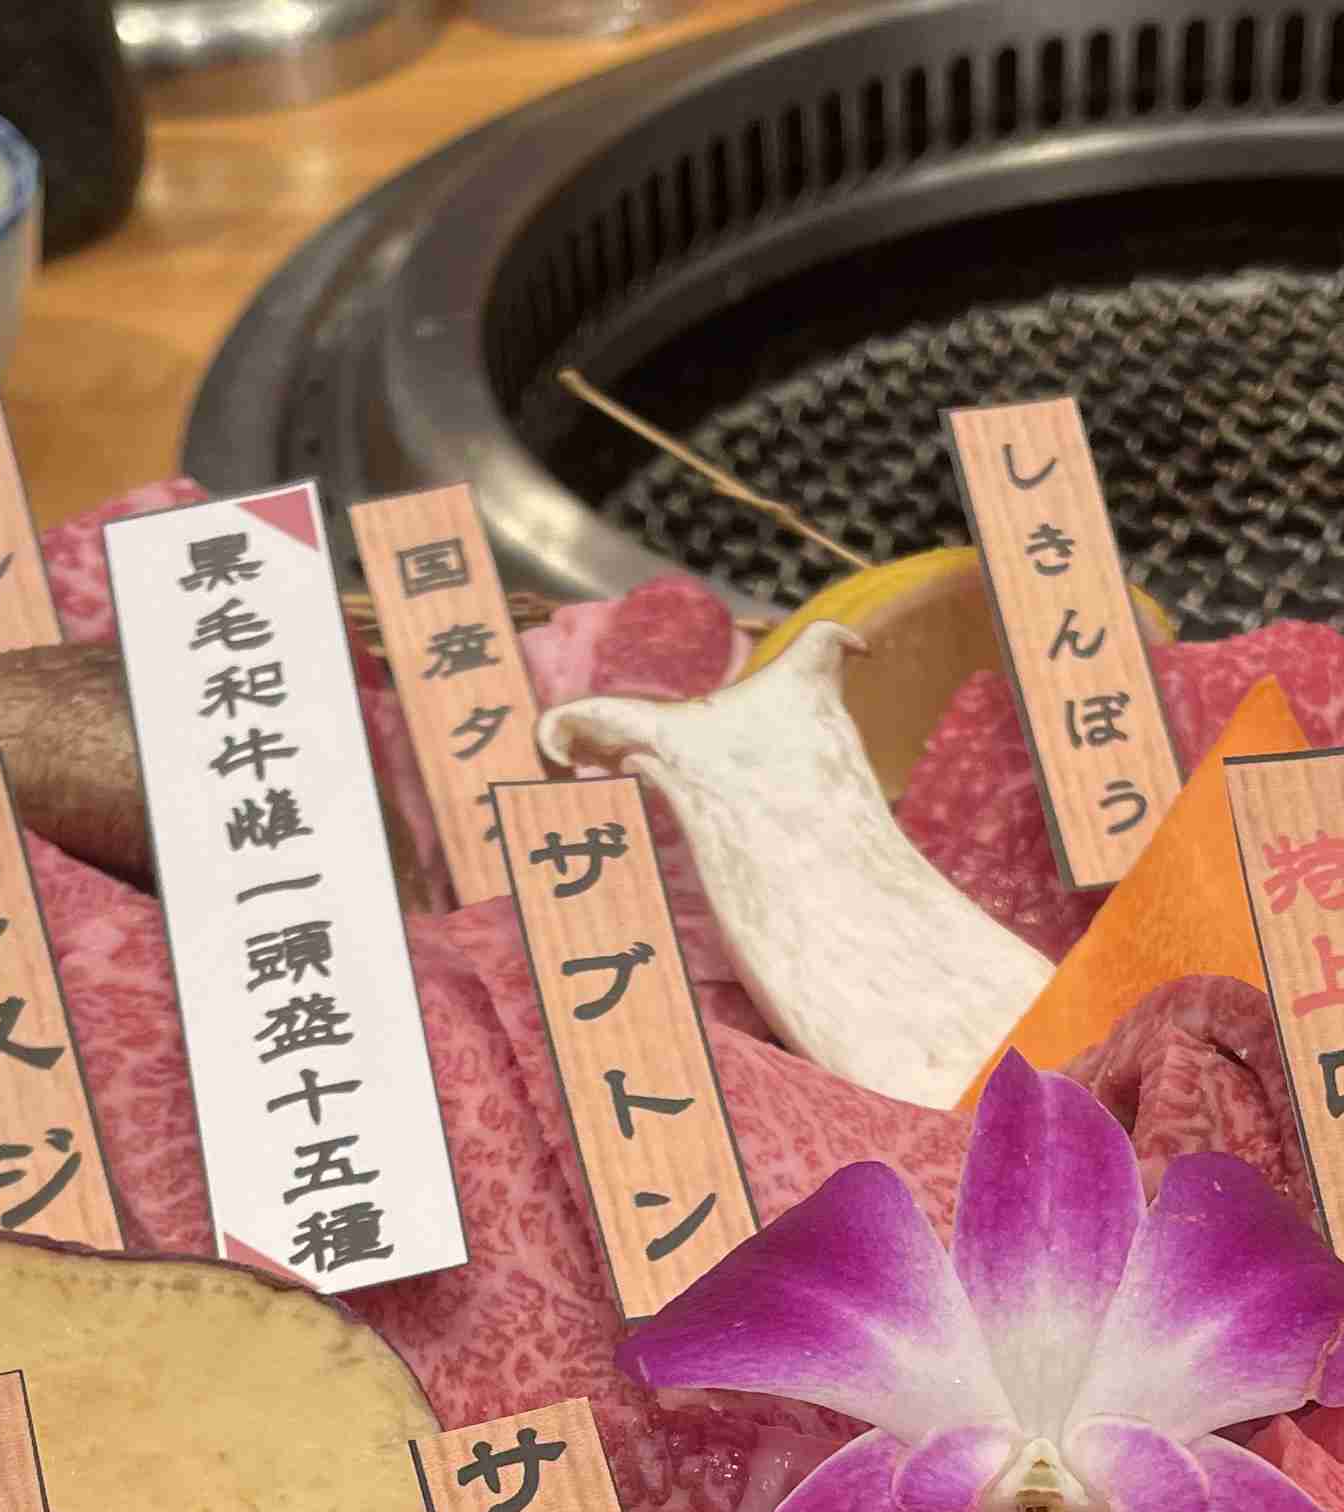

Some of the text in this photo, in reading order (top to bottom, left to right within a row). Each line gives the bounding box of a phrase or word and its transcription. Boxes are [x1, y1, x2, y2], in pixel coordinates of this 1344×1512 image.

[1002, 443, 1149, 836] しきんぼう
[179, 533, 394, 1273] 黒毛和牛雌一頭盛十五種
[529, 823, 718, 1262] ザブトン
